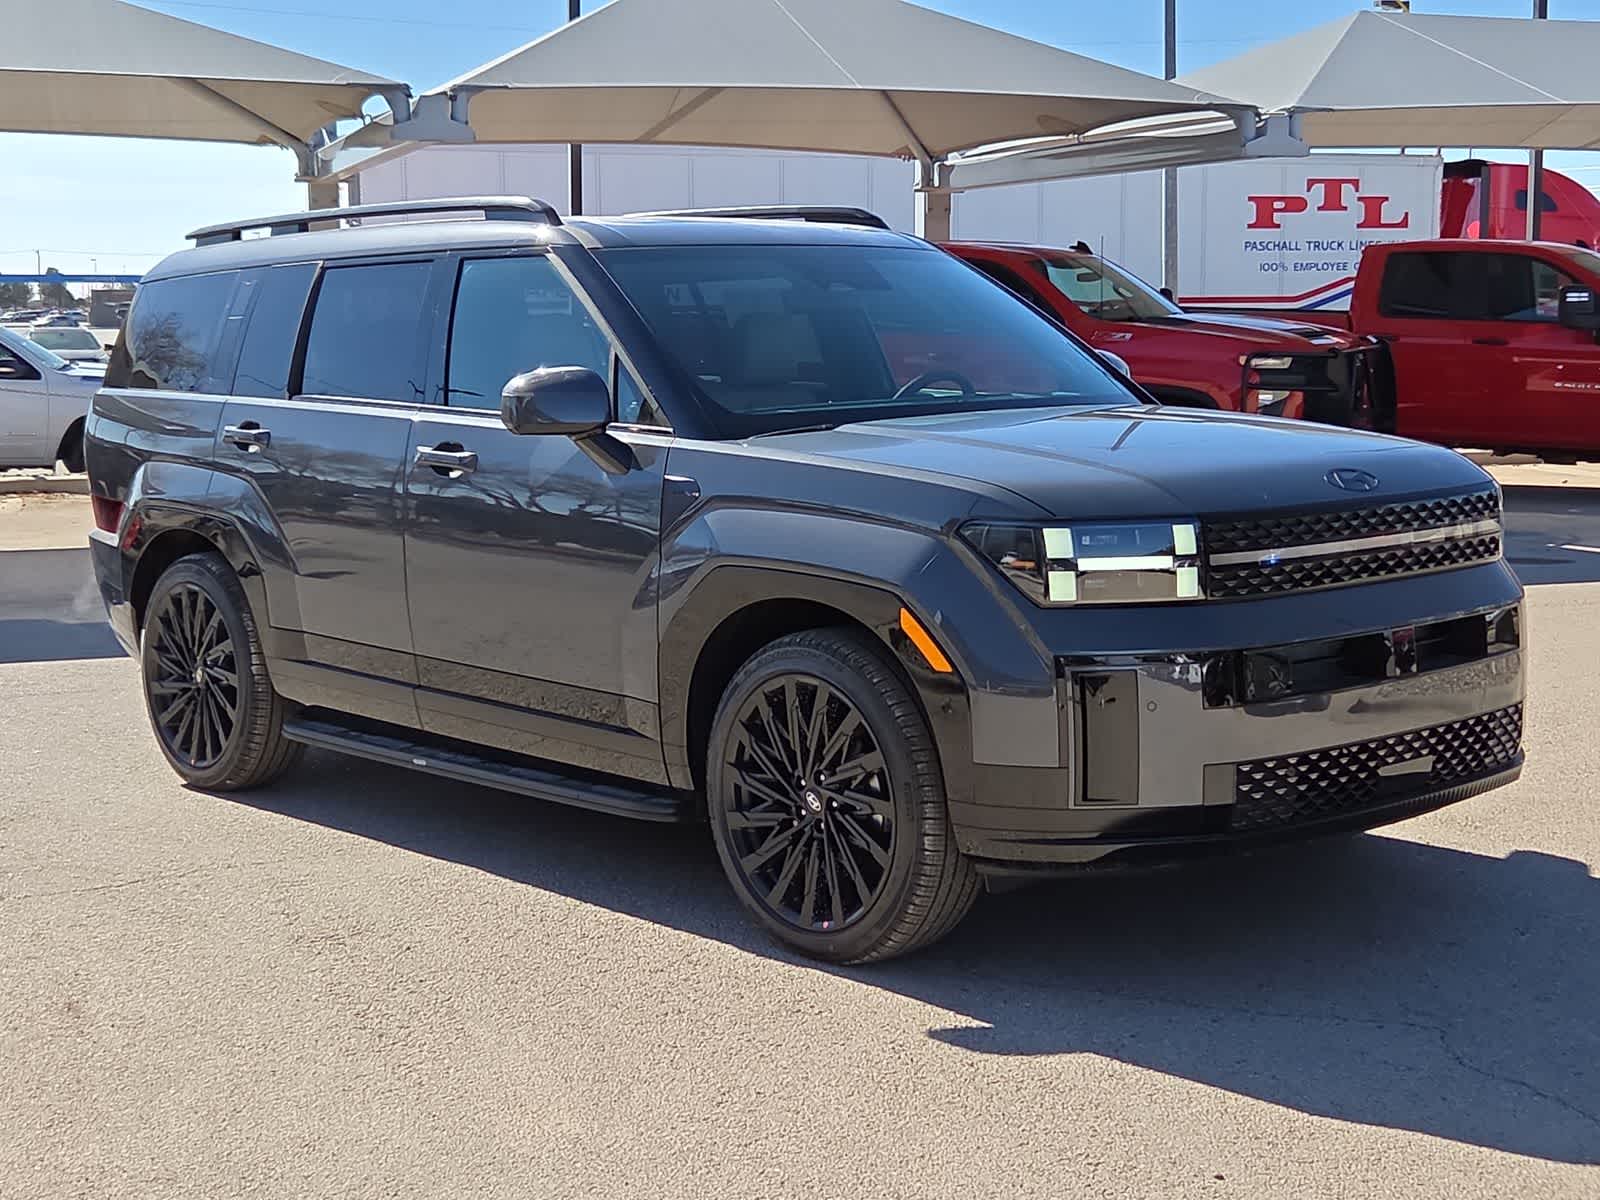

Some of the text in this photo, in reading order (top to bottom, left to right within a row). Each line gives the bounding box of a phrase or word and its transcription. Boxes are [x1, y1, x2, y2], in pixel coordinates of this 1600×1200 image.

[1247, 178, 1409, 229] PTL
[1244, 240, 1301, 252] PASCHALL
[1306, 240, 1345, 251] TRUCK
[1260, 262, 1289, 272] 100%
[1293, 261, 1349, 272] EMPLOYEE
